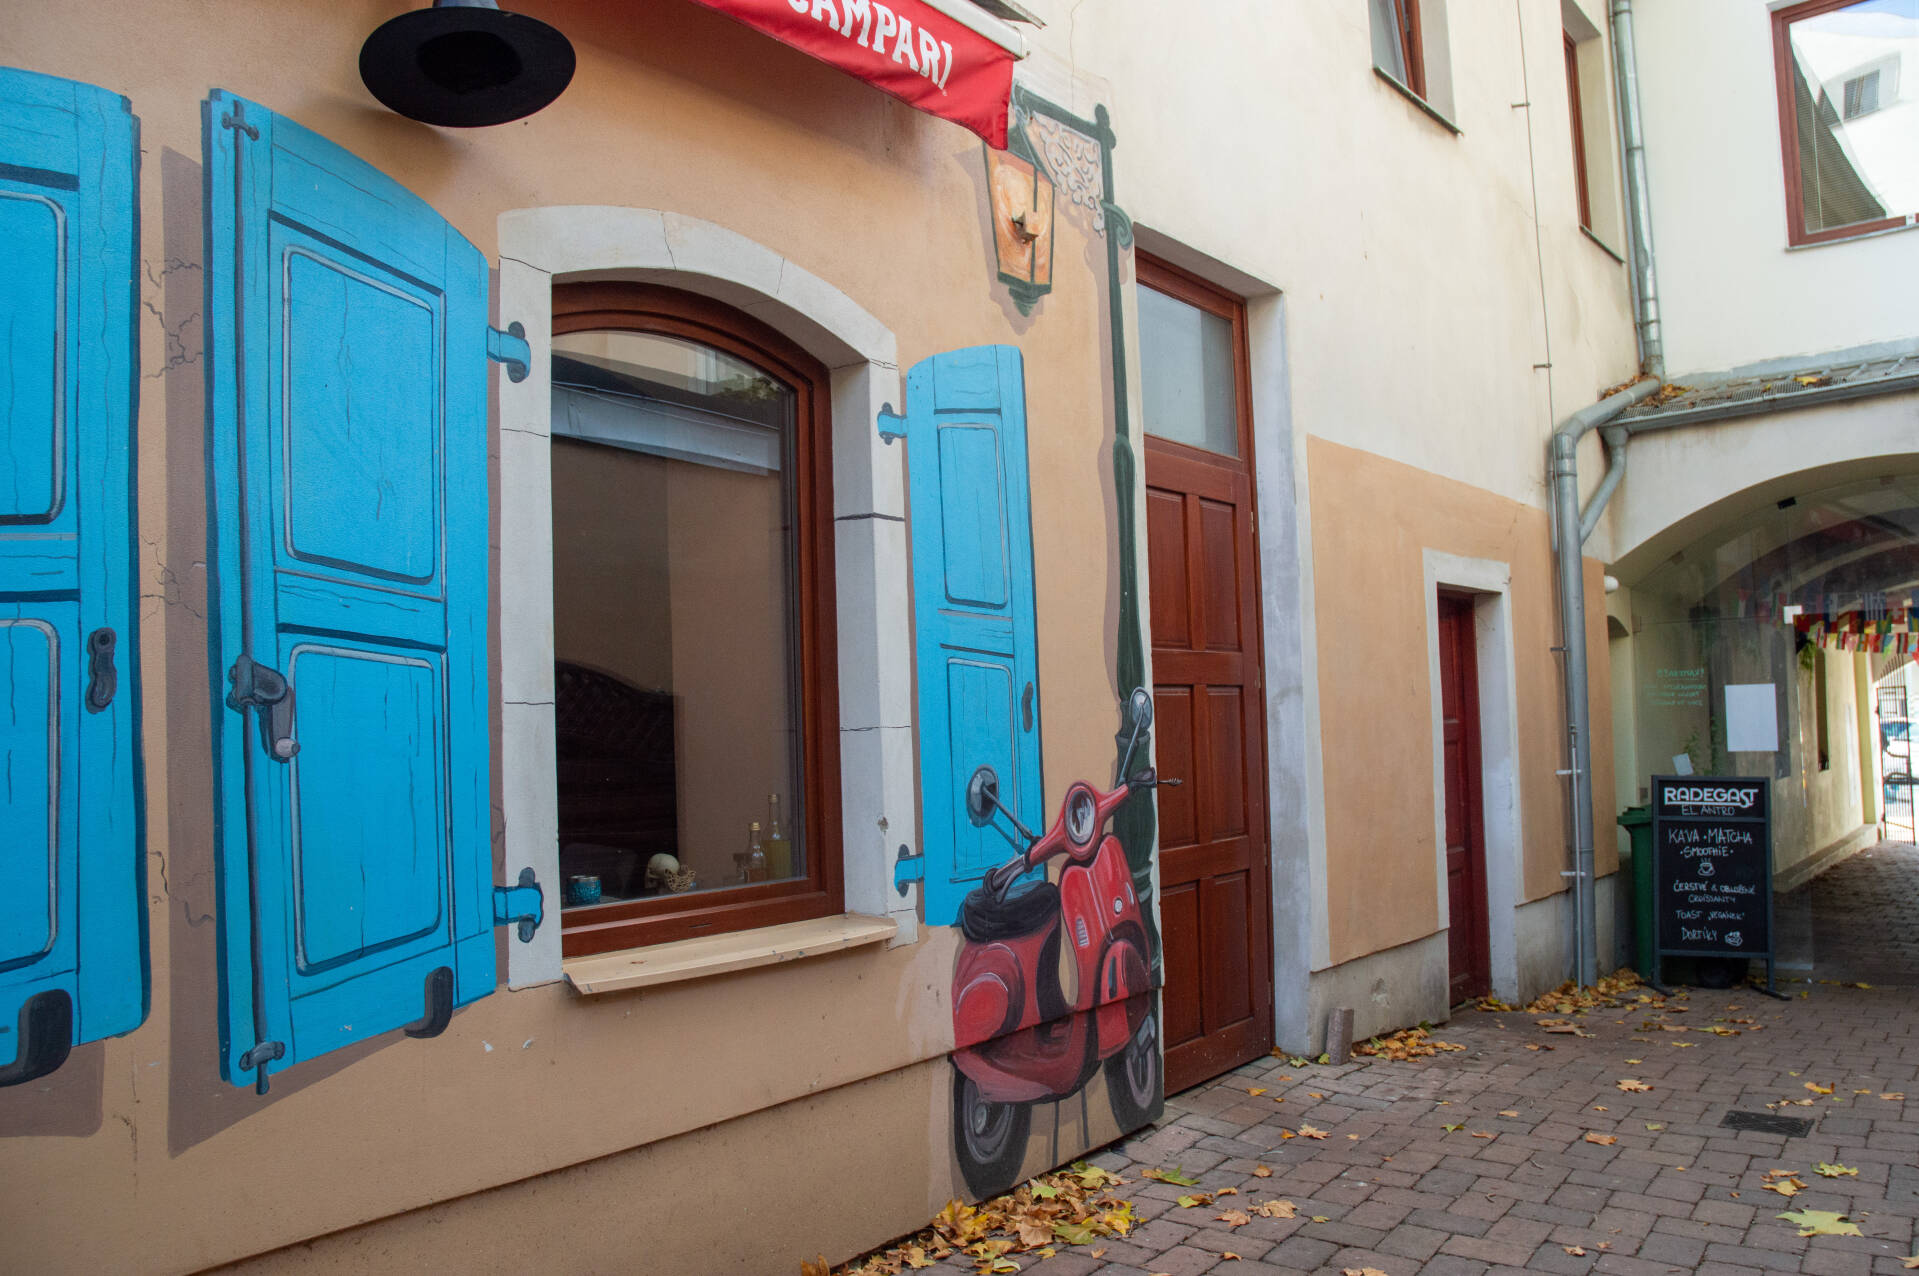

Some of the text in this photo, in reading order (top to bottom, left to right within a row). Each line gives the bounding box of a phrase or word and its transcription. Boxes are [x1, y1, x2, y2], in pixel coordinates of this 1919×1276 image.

[1664, 786, 1759, 808] RADEGAST
[1681, 805, 1735, 816] EL ANTRO
